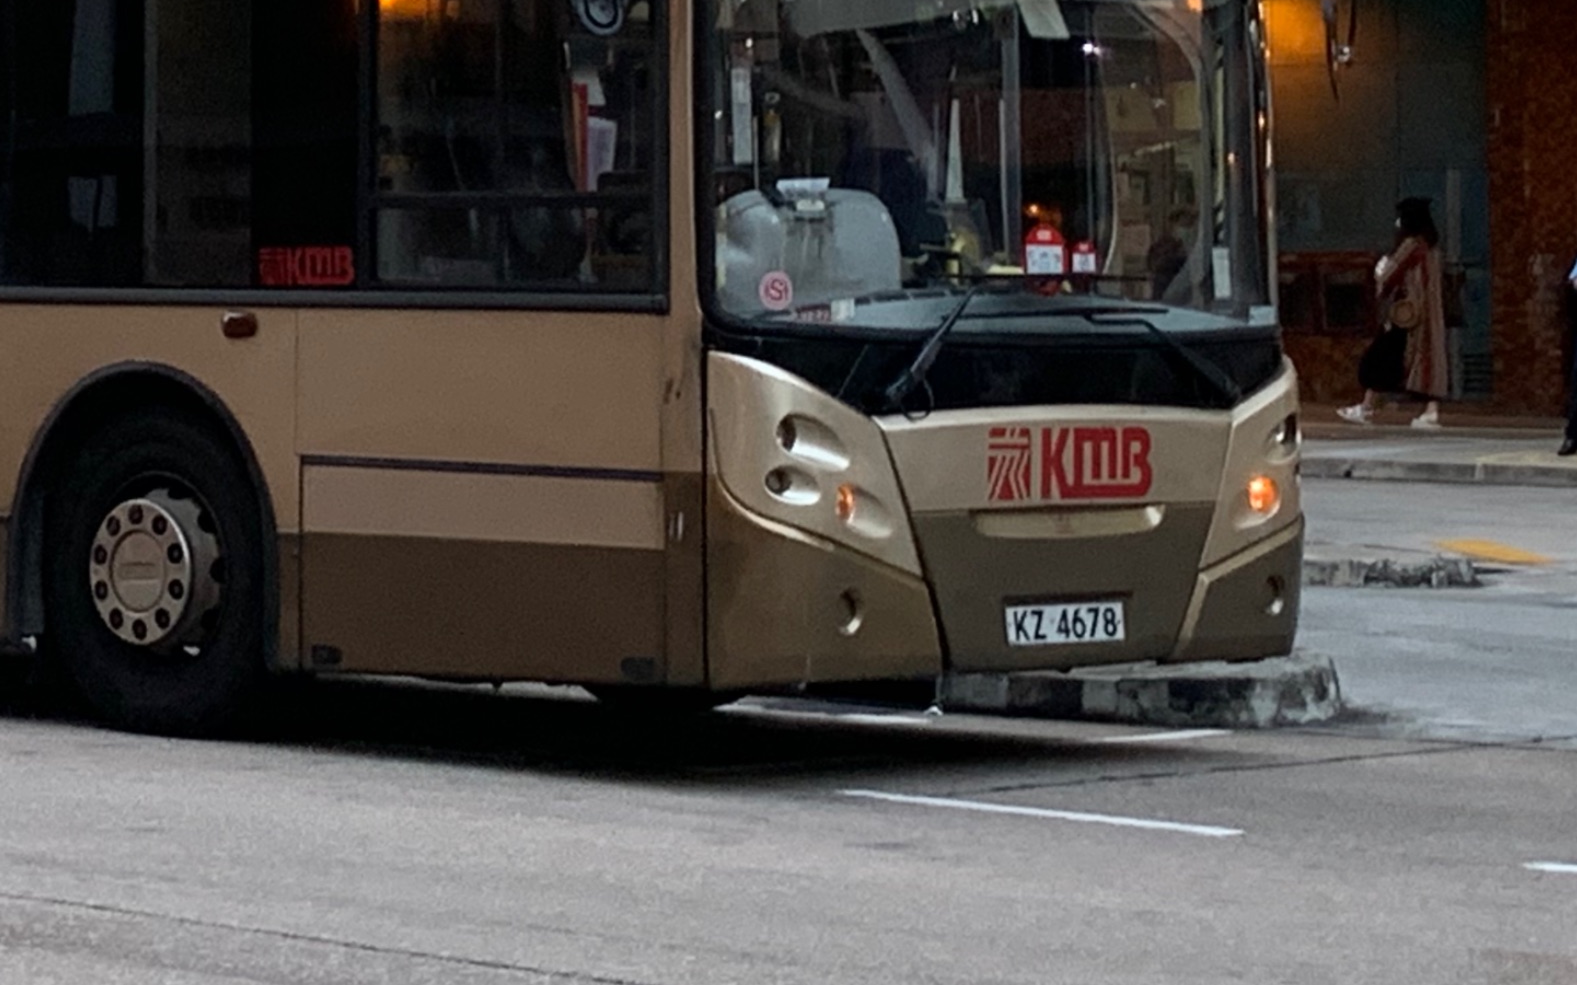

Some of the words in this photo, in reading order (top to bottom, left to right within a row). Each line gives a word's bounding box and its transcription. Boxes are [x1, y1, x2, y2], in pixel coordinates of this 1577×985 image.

[1040, 426, 1152, 499] KMB
[1013, 610, 1047, 641] KZ
[1056, 607, 1117, 639] 4678
